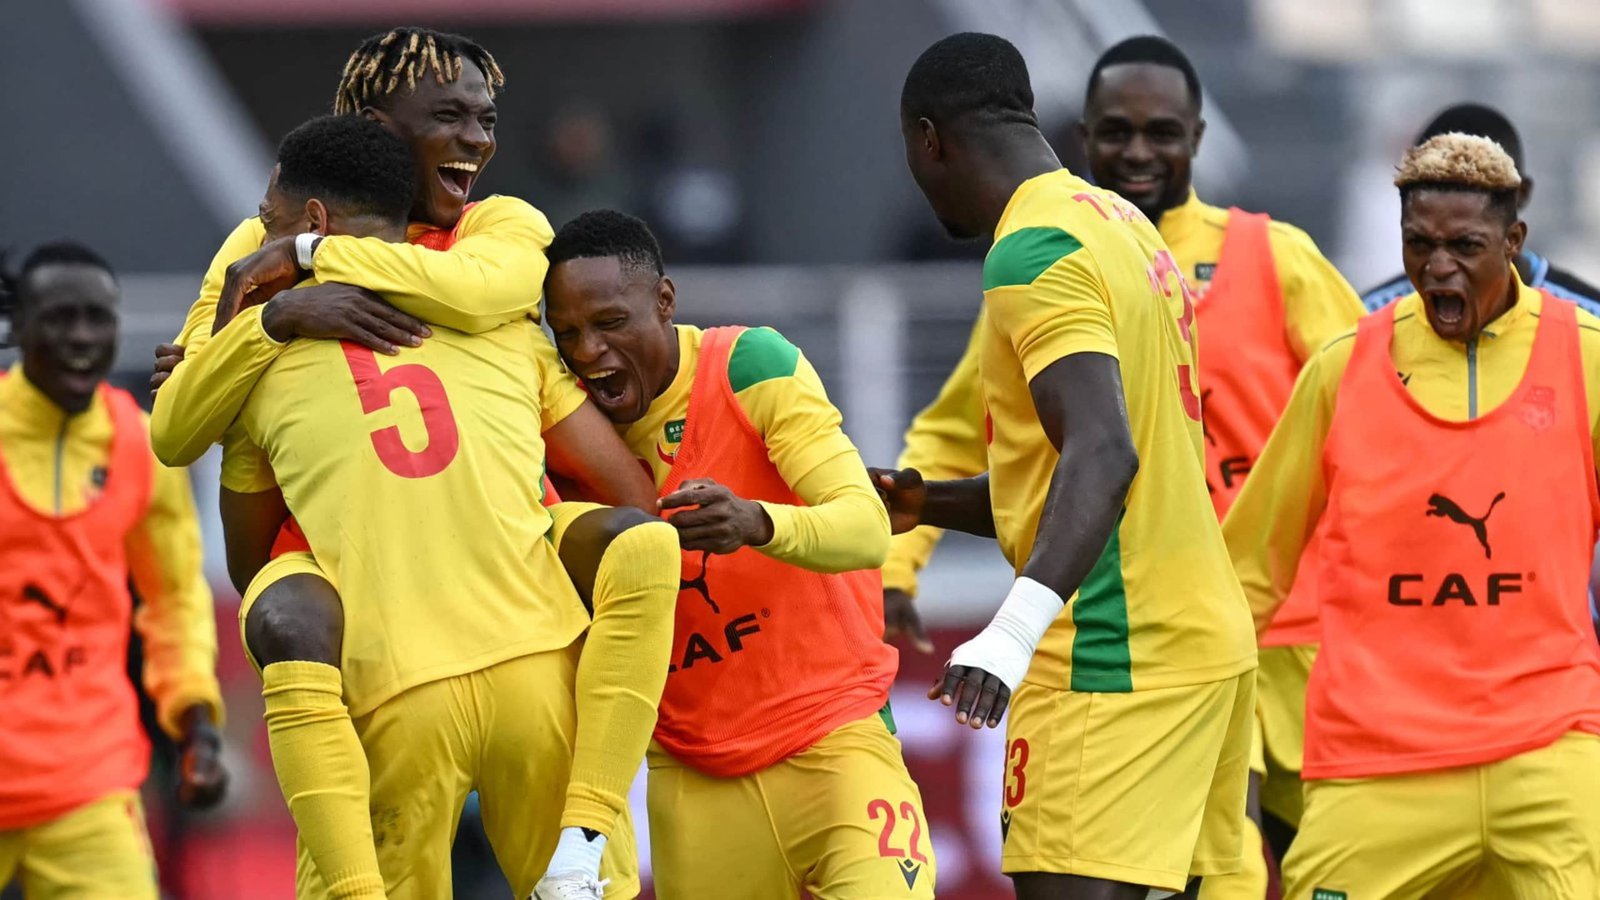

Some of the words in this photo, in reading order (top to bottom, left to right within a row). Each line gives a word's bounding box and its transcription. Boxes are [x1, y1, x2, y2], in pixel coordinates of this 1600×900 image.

[339, 339, 459, 478] 5
[1388, 573, 1522, 606] CAF
[668, 613, 760, 673] AF
[867, 799, 928, 865] 22
